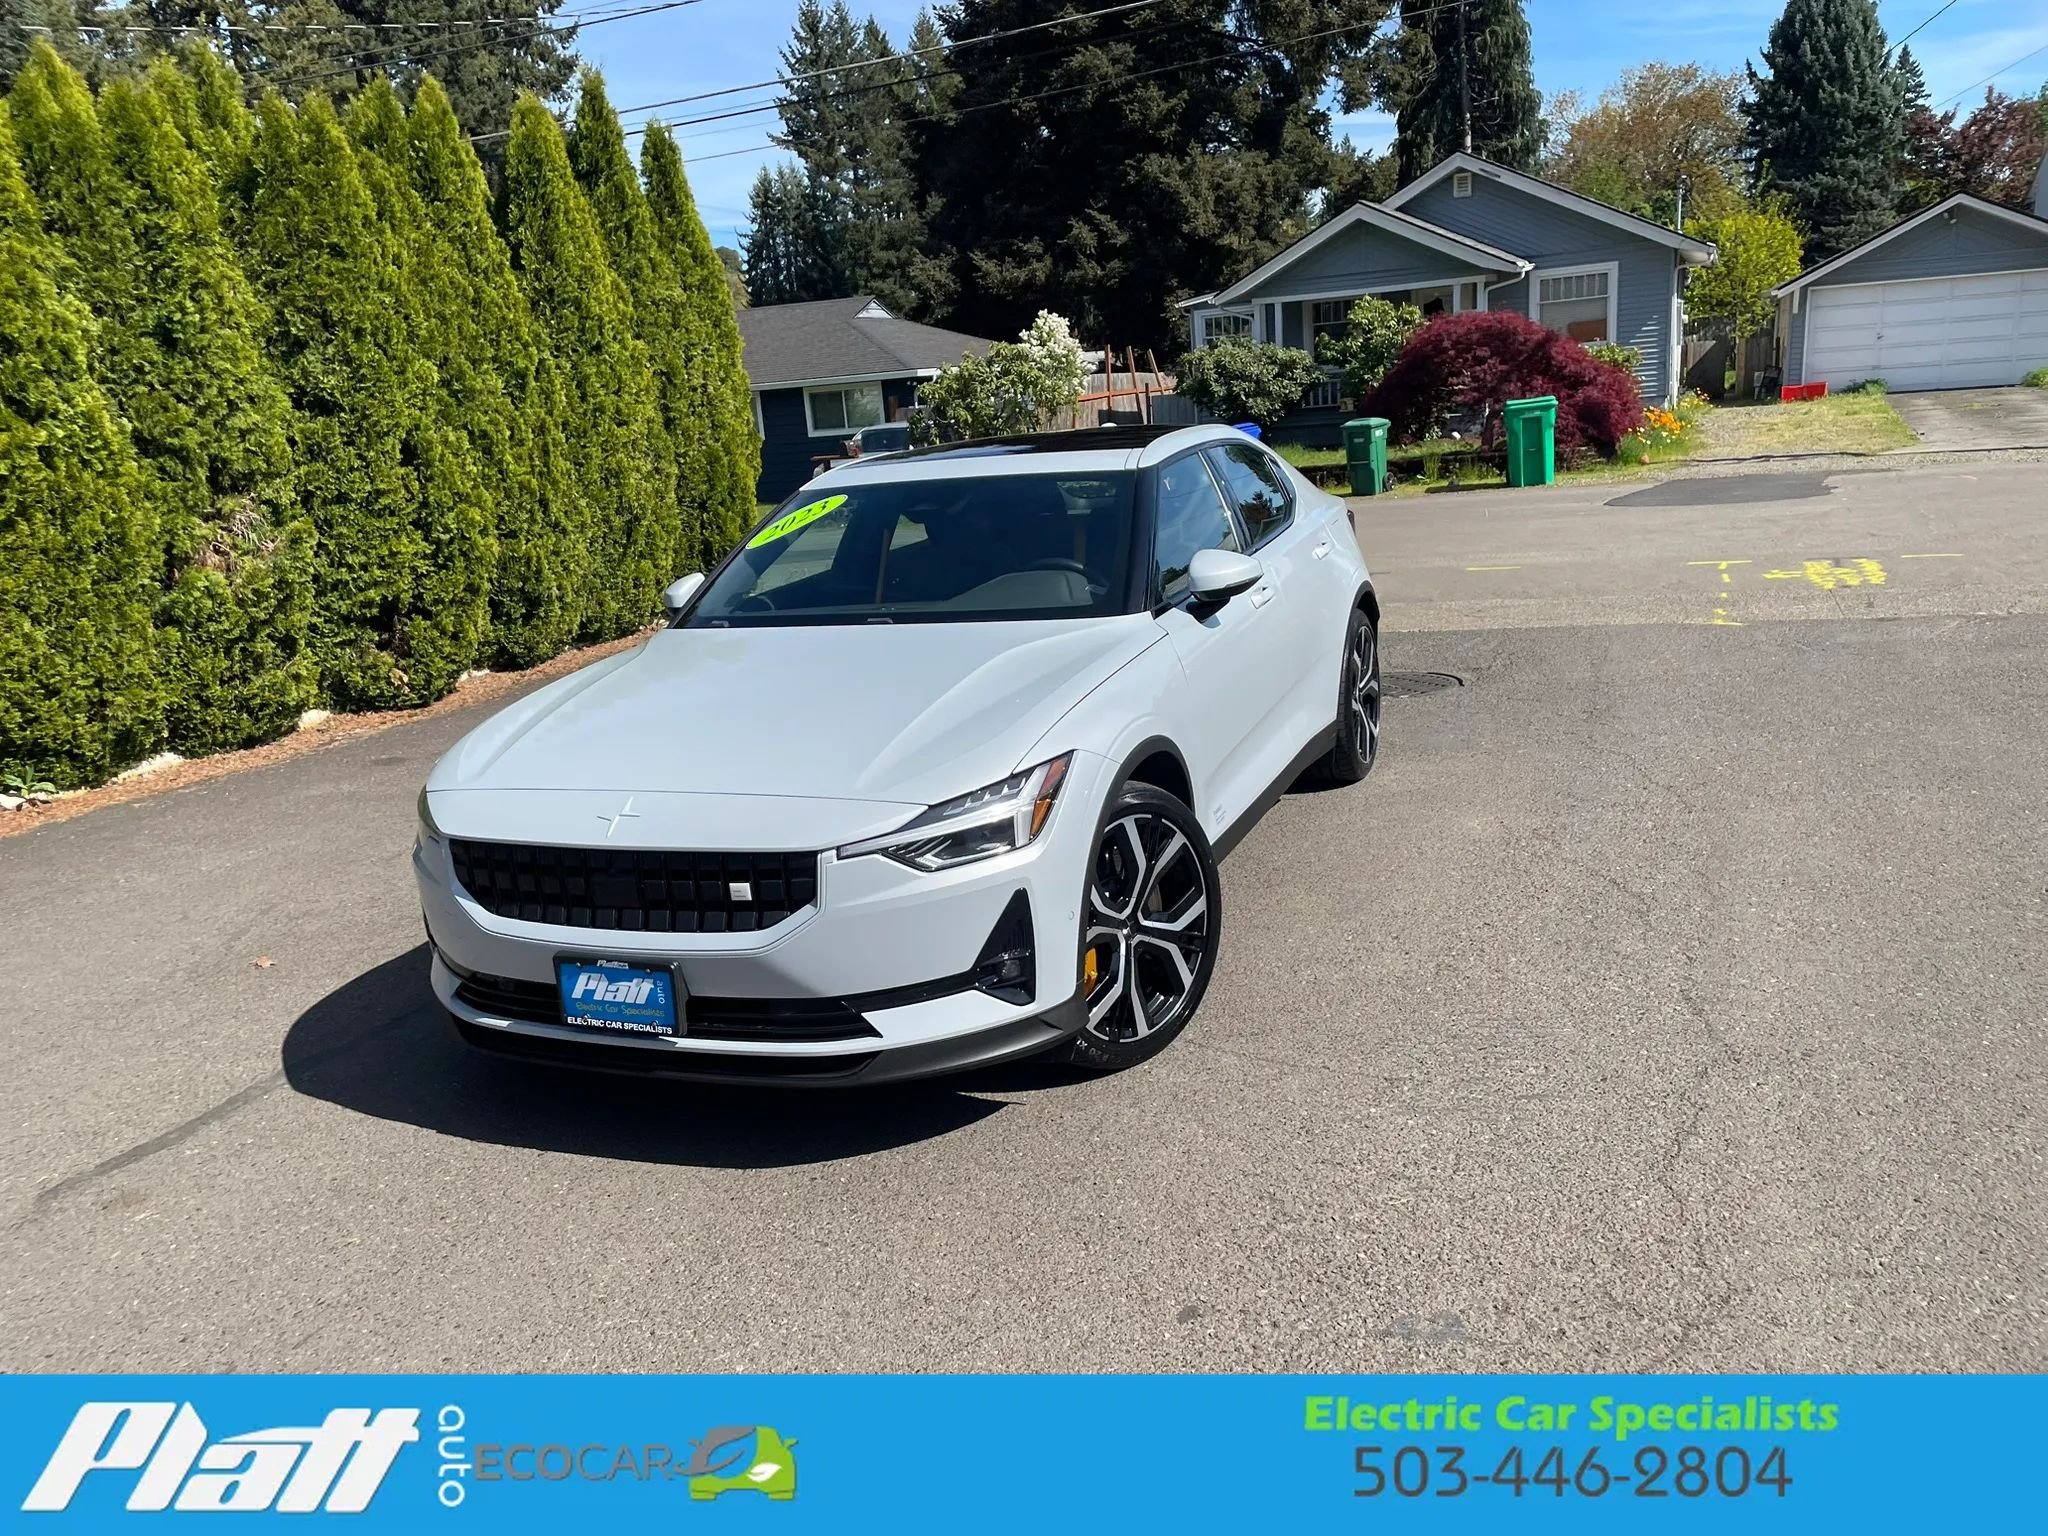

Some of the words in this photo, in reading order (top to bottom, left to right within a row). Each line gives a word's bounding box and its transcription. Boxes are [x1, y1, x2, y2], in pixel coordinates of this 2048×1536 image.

[763, 500, 829, 541] 2023
[571, 972, 655, 1005] Platt
[656, 980, 665, 1004] auto
[567, 1016, 604, 1027] ELECTRIC
[605, 1020, 623, 1029] CAR
[623, 1022, 673, 1035] SPECIALISTS
